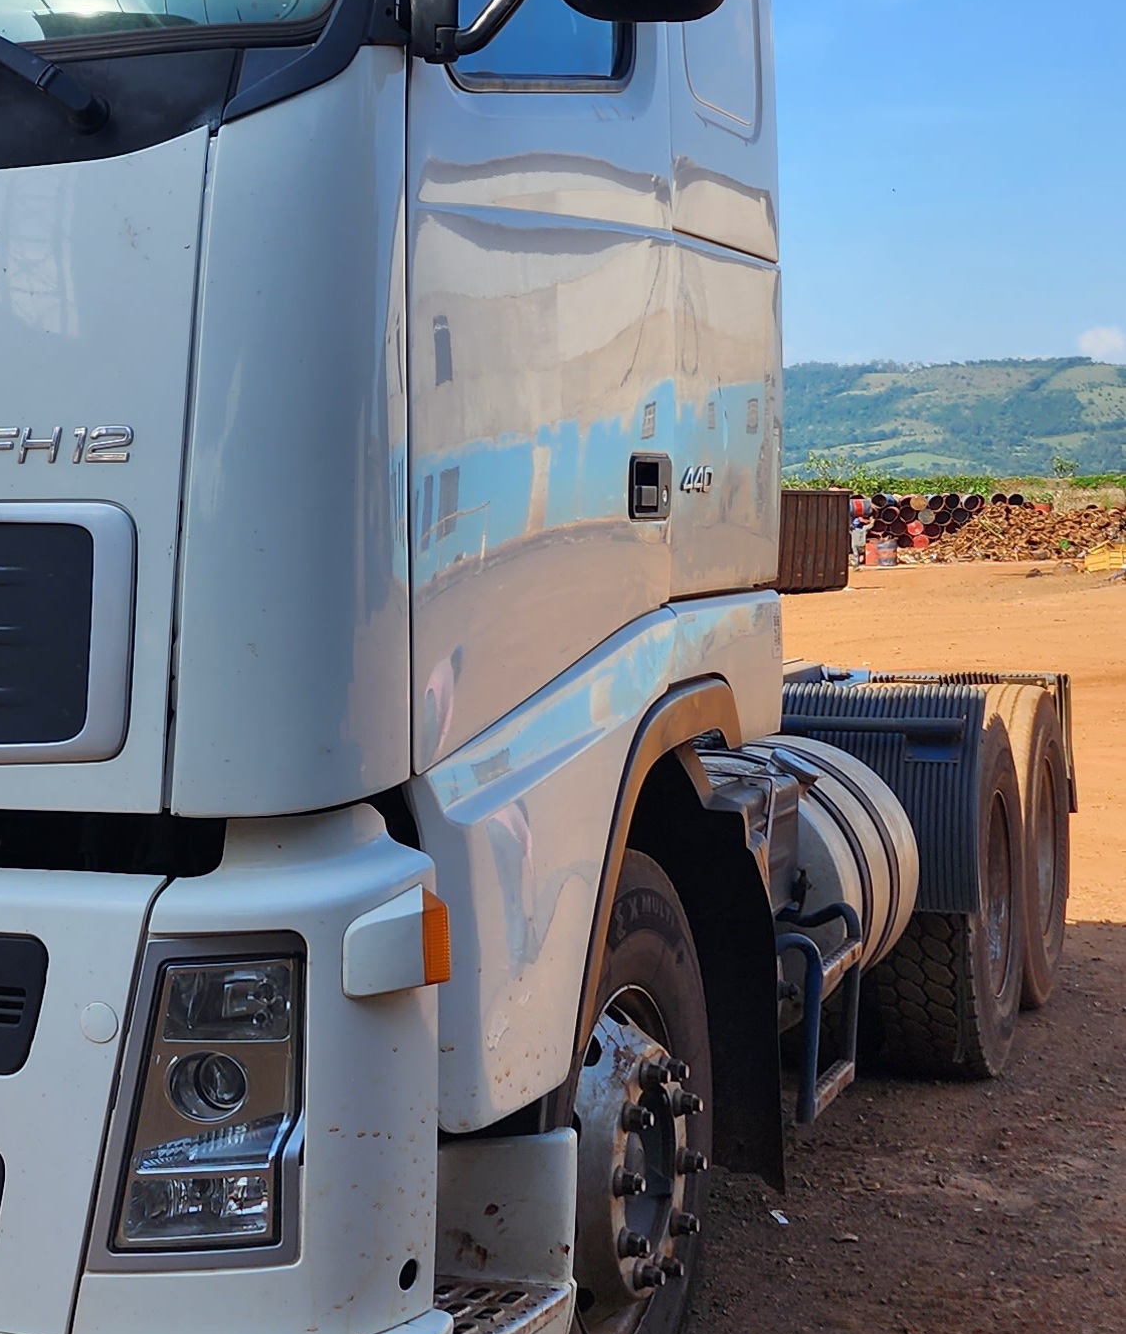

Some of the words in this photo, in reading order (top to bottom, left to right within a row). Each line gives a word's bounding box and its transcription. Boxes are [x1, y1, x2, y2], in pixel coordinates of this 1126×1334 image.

[680, 465, 714, 494] 440
[628, 896, 639, 923] X
[642, 893, 675, 928] MULTI
